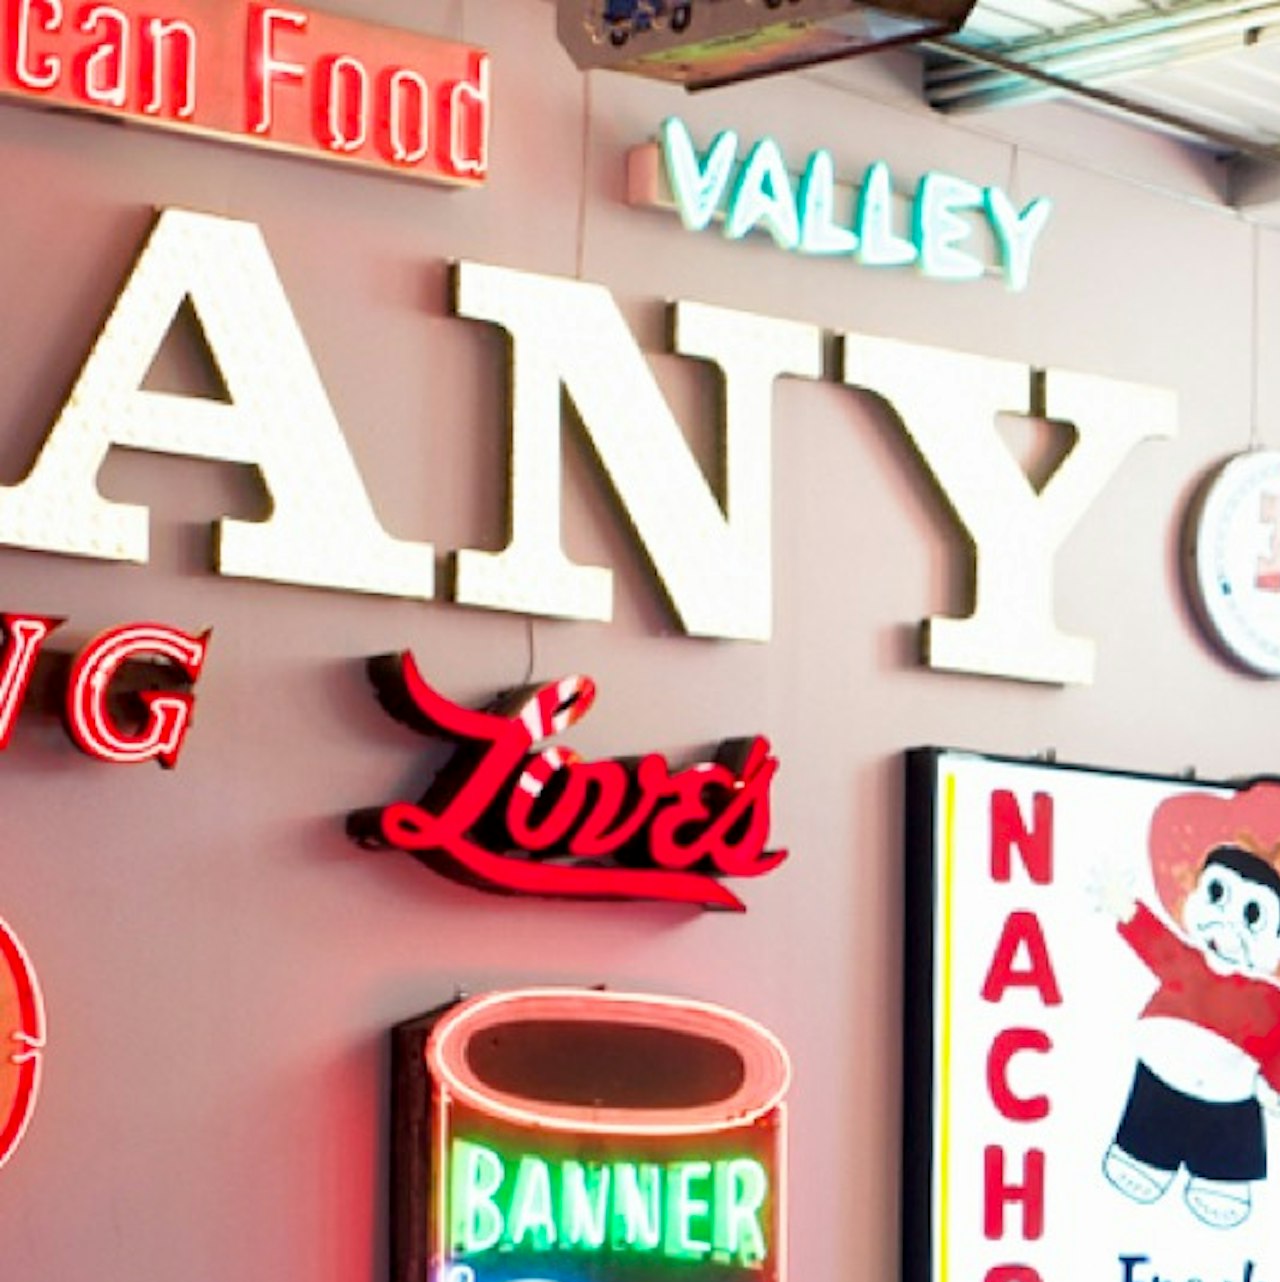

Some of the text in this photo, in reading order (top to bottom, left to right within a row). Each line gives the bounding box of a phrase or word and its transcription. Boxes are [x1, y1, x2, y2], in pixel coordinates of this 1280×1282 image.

[250, 6, 490, 175] Food
[657, 114, 1052, 293] VALLEY
[0, 205, 1179, 686] ANY
[452, 1138, 769, 1269] BANNER
